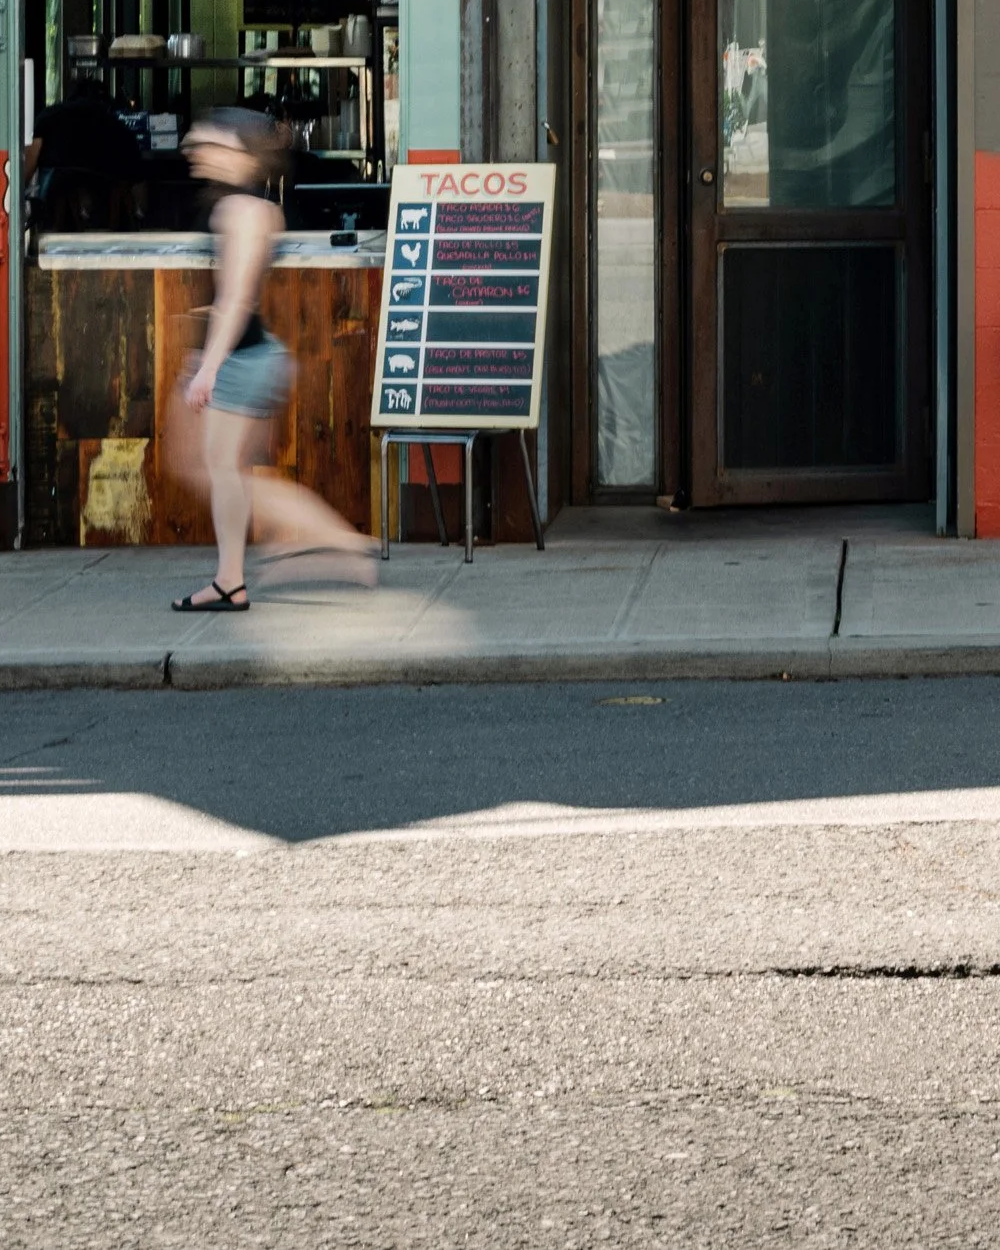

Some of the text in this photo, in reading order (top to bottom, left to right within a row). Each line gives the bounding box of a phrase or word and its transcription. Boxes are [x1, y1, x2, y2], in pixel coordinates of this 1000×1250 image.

[420, 171, 528, 197] TACOS
[434, 276, 466, 286] TACO
[452, 286, 514, 298] CAMARON
[429, 350, 456, 358] TACO
